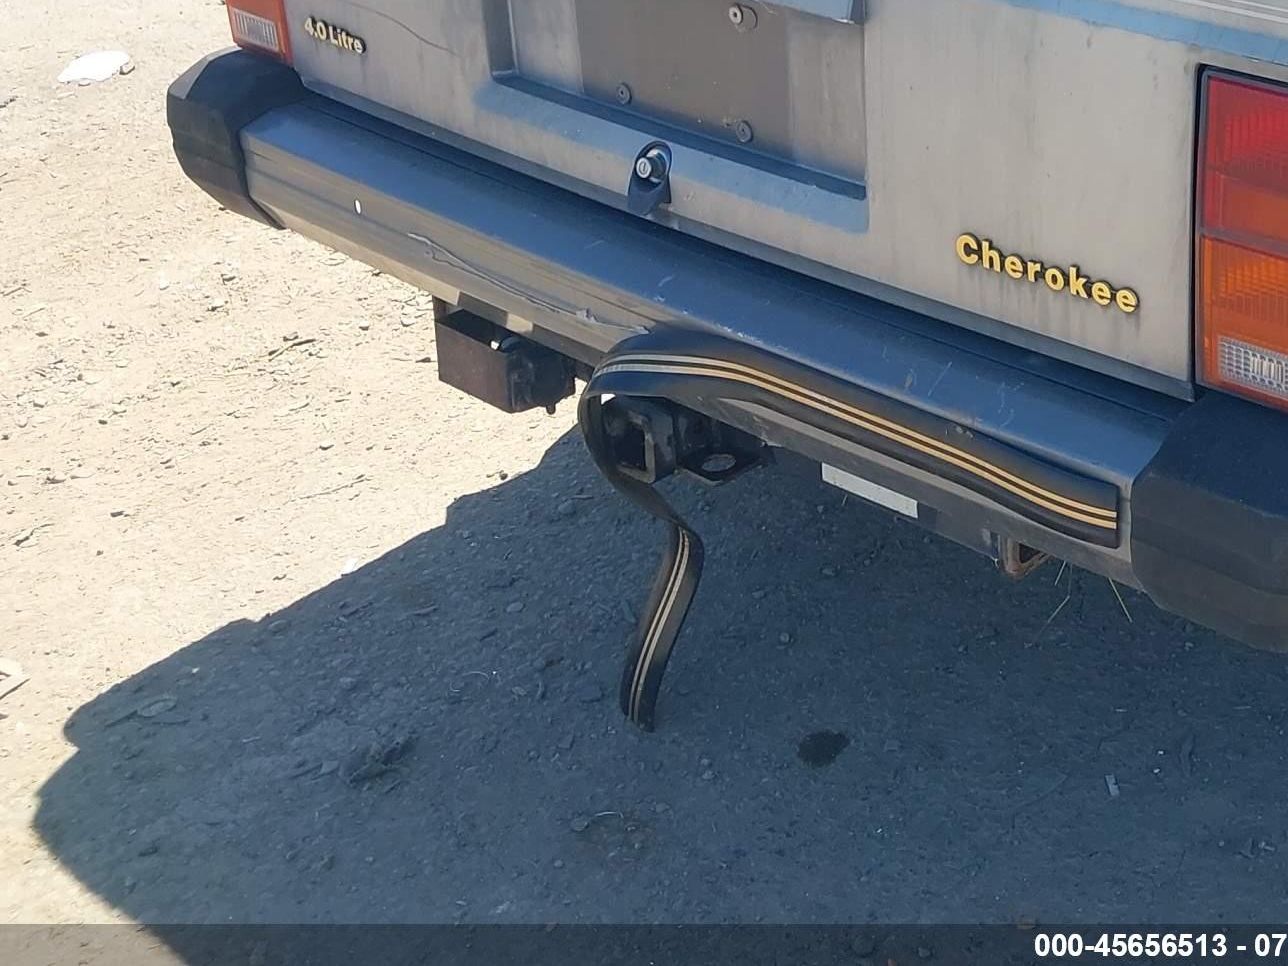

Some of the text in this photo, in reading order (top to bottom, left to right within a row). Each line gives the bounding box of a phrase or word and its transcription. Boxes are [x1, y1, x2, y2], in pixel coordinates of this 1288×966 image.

[304, 16, 366, 54] 4.0 Litre
[955, 233, 1139, 313] Cherokee
